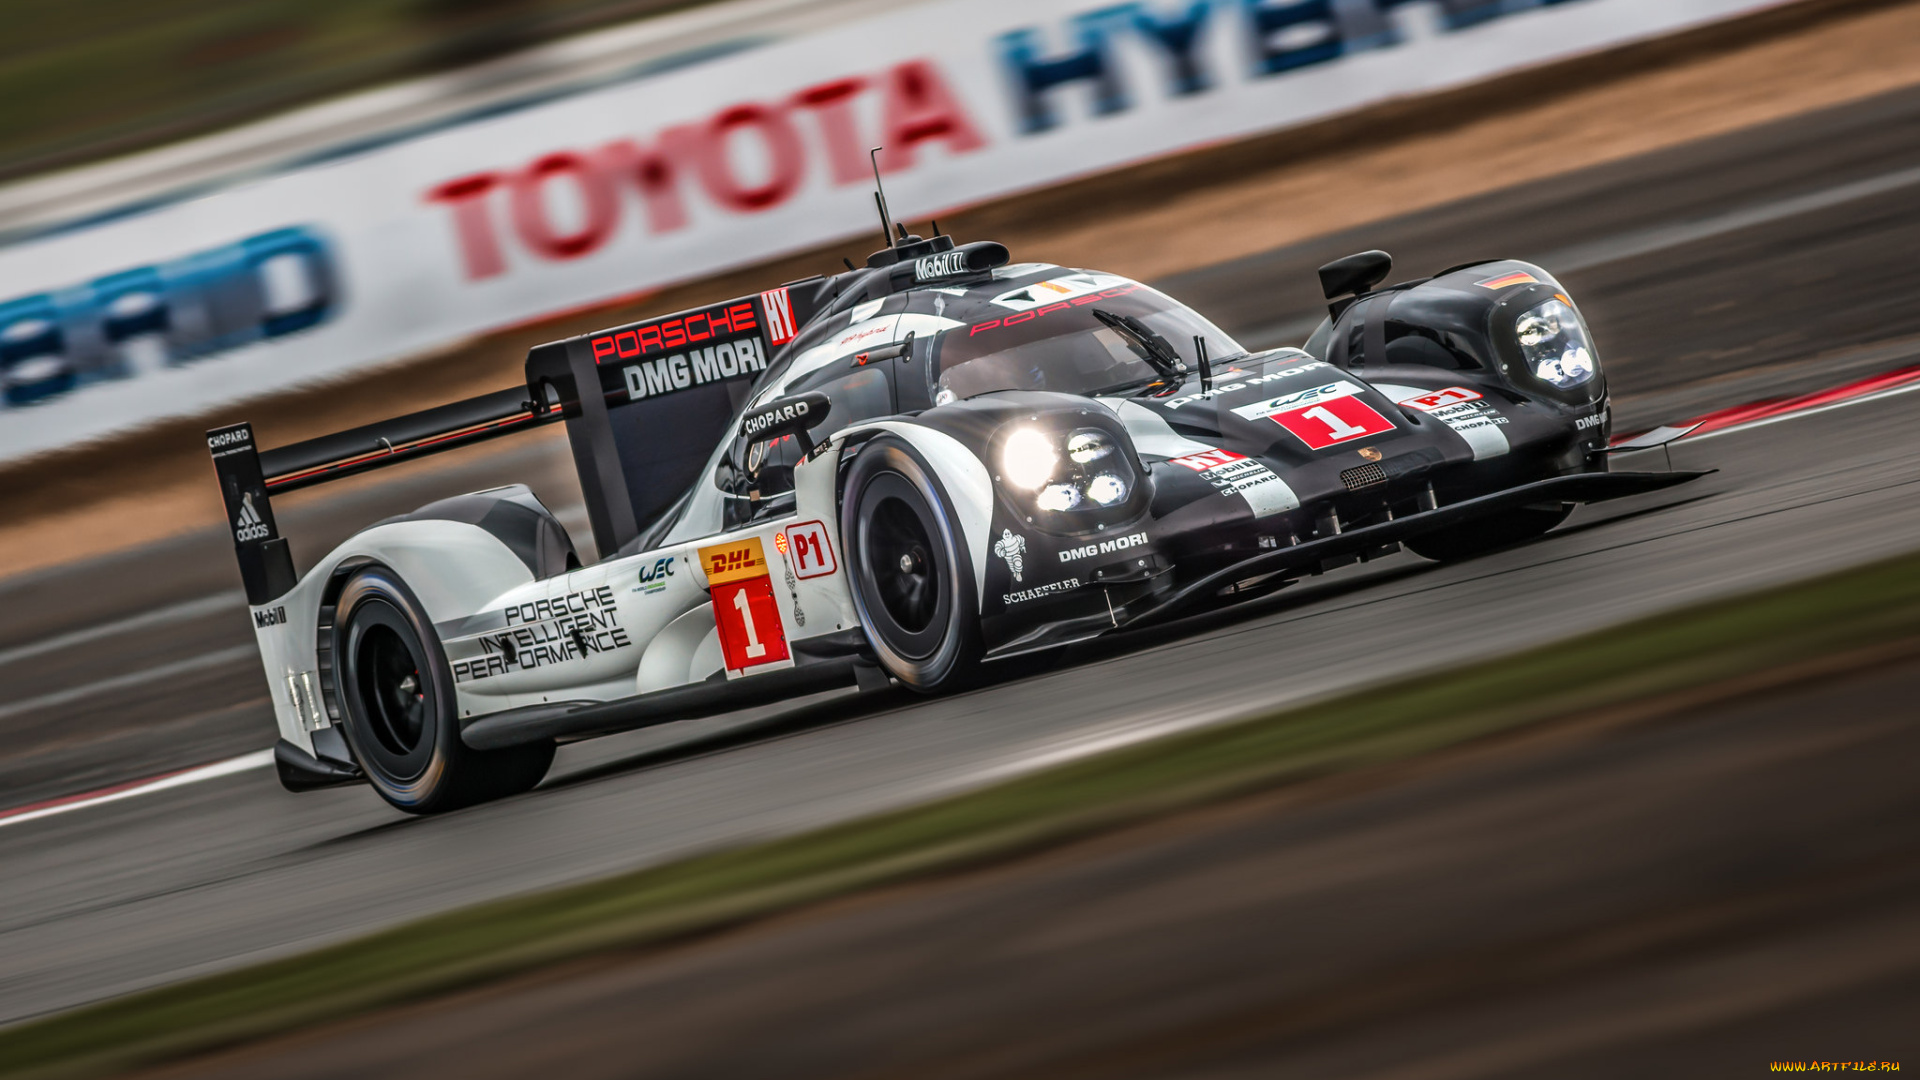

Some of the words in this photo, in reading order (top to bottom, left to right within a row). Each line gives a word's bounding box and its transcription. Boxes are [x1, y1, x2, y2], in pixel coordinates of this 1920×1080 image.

[420, 58, 985, 284] TOYOTA
[988, 0, 1570, 135] HYB
[915, 253, 950, 280] Mobil
[761, 289, 794, 344] HY
[969, 284, 1148, 337] PORSCH
[591, 303, 756, 364] PORSCHE
[623, 354, 690, 400] DMG
[690, 337, 767, 385] MORI
[1164, 382, 1246, 410] DMG
[1269, 384, 1337, 408] WEC
[1414, 390, 1467, 406] P1
[1432, 403, 1474, 417] Mobil
[745, 401, 809, 434] CHOPARD
[1301, 405, 1367, 440] 1
[1454, 418, 1507, 431] CHOPARD
[1575, 414, 1600, 430] DMG
[207, 429, 249, 448] CHOPARD
[1173, 451, 1236, 469] HY
[1201, 463, 1244, 480] Mobil
[1222, 474, 1277, 495] CHOPARD
[237, 524, 269, 541] adidas
[711, 548, 756, 574] DHL
[793, 531, 825, 570] P1
[1059, 545, 1098, 563] DMG
[1100, 532, 1149, 554] MORI
[639, 557, 675, 583] WEC
[1002, 577, 1080, 605] SCHAEFFLER
[254, 608, 278, 629] Mobil
[504, 585, 616, 627] PORSCHE
[478, 607, 618, 655] INTELLIGENT
[733, 588, 766, 659] 1
[452, 628, 632, 683] PERFORMANCE
